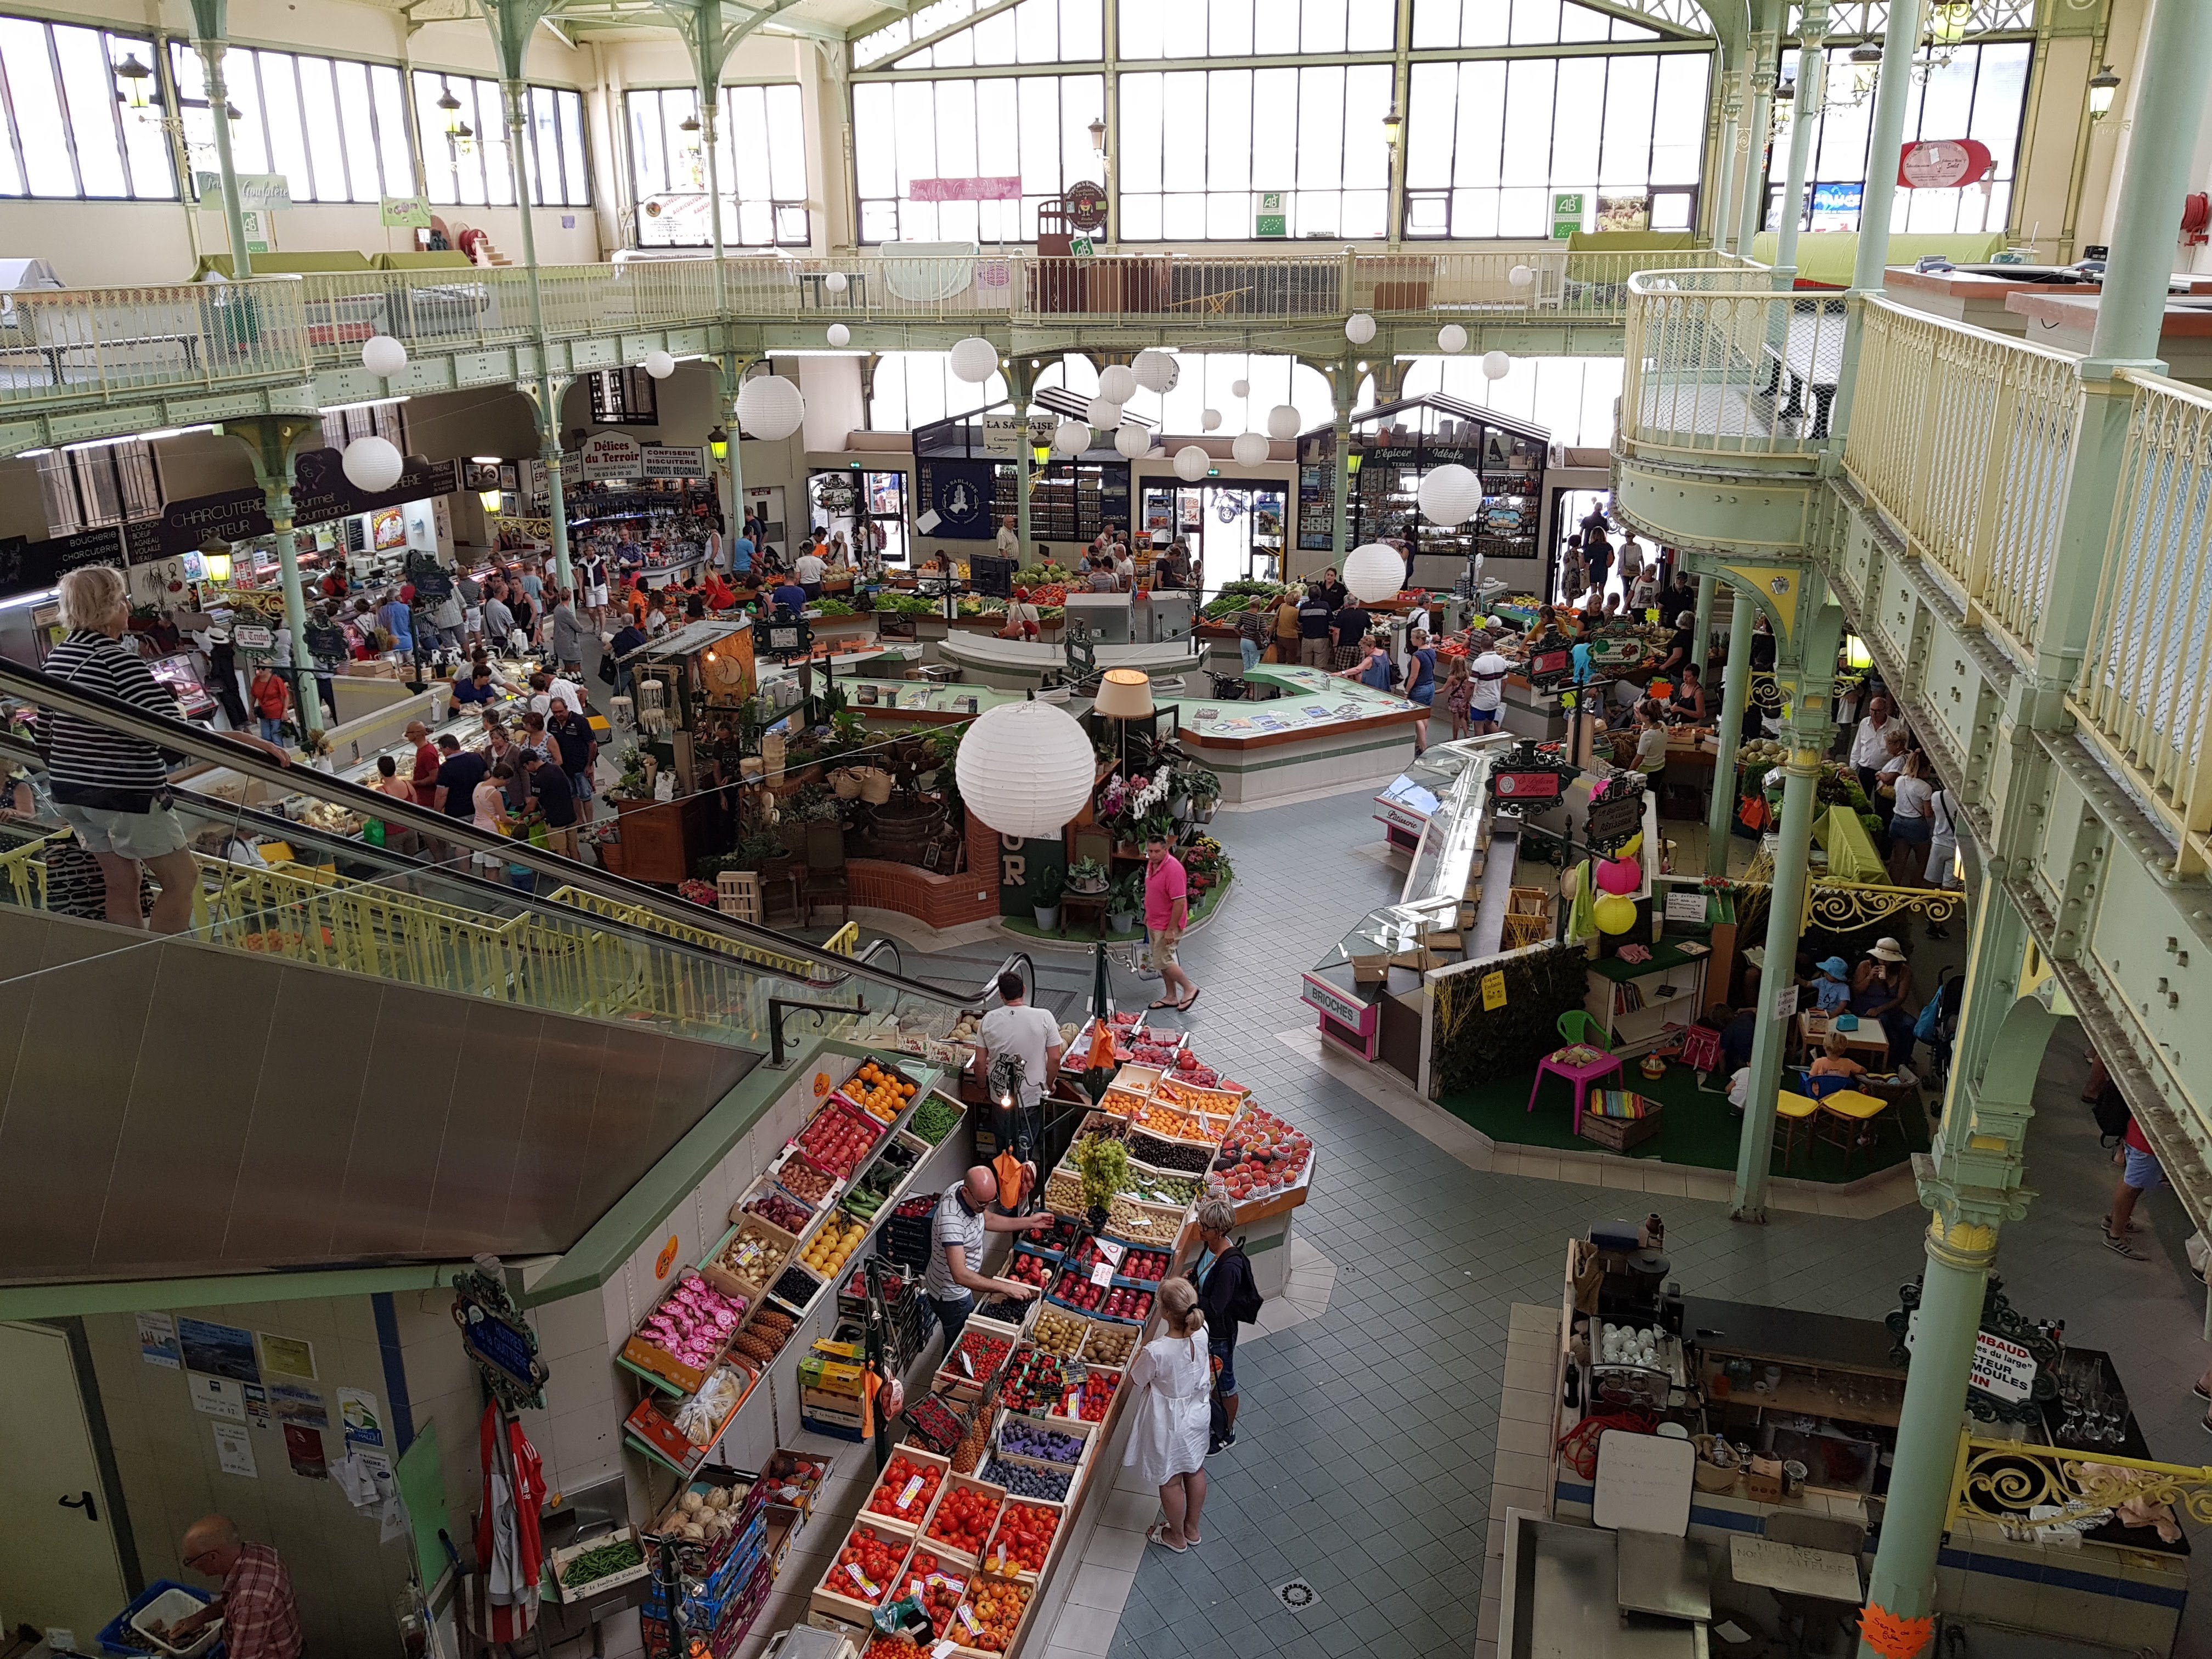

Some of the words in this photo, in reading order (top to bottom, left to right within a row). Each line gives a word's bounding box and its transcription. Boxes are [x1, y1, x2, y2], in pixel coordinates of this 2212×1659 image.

[1264, 197, 1277, 208] AB
[1559, 199, 1576, 212] AB
[244, 218, 257, 232] AB
[1076, 244, 1091, 256] AB
[1003, 421, 1053, 430] SAAISE
[594, 440, 629, 452] Délices
[585, 454, 599, 464] du
[602, 452, 640, 463] Terroir
[566, 464, 579, 475] FINE
[646, 466, 671, 475] PRODUITS
[295, 493, 335, 509] ourmet
[171, 497, 264, 528] CHARCUTERIE
[295, 500, 351, 522] ourmand
[131, 520, 159, 532] COCHON
[193, 520, 250, 543] TRITEUR
[132, 529, 151, 540] BOEUF
[133, 537, 159, 548] AGNEAU
[134, 544, 161, 555] VOLAILLE
[136, 554, 153, 562] VEAU
[1386, 810, 1417, 828] Pâtisserie
[1484, 974, 1500, 983] Espace
[1485, 981, 1502, 990] Enfants
[1779, 990, 1795, 998] Espace
[1312, 987, 1354, 1022] BRIOCHES
[1778, 998, 1795, 1006] Enfants
[1977, 1345, 1987, 1353] es
[1990, 1349, 2001, 1359] du
[1971, 1362, 2028, 1390] MOULES
